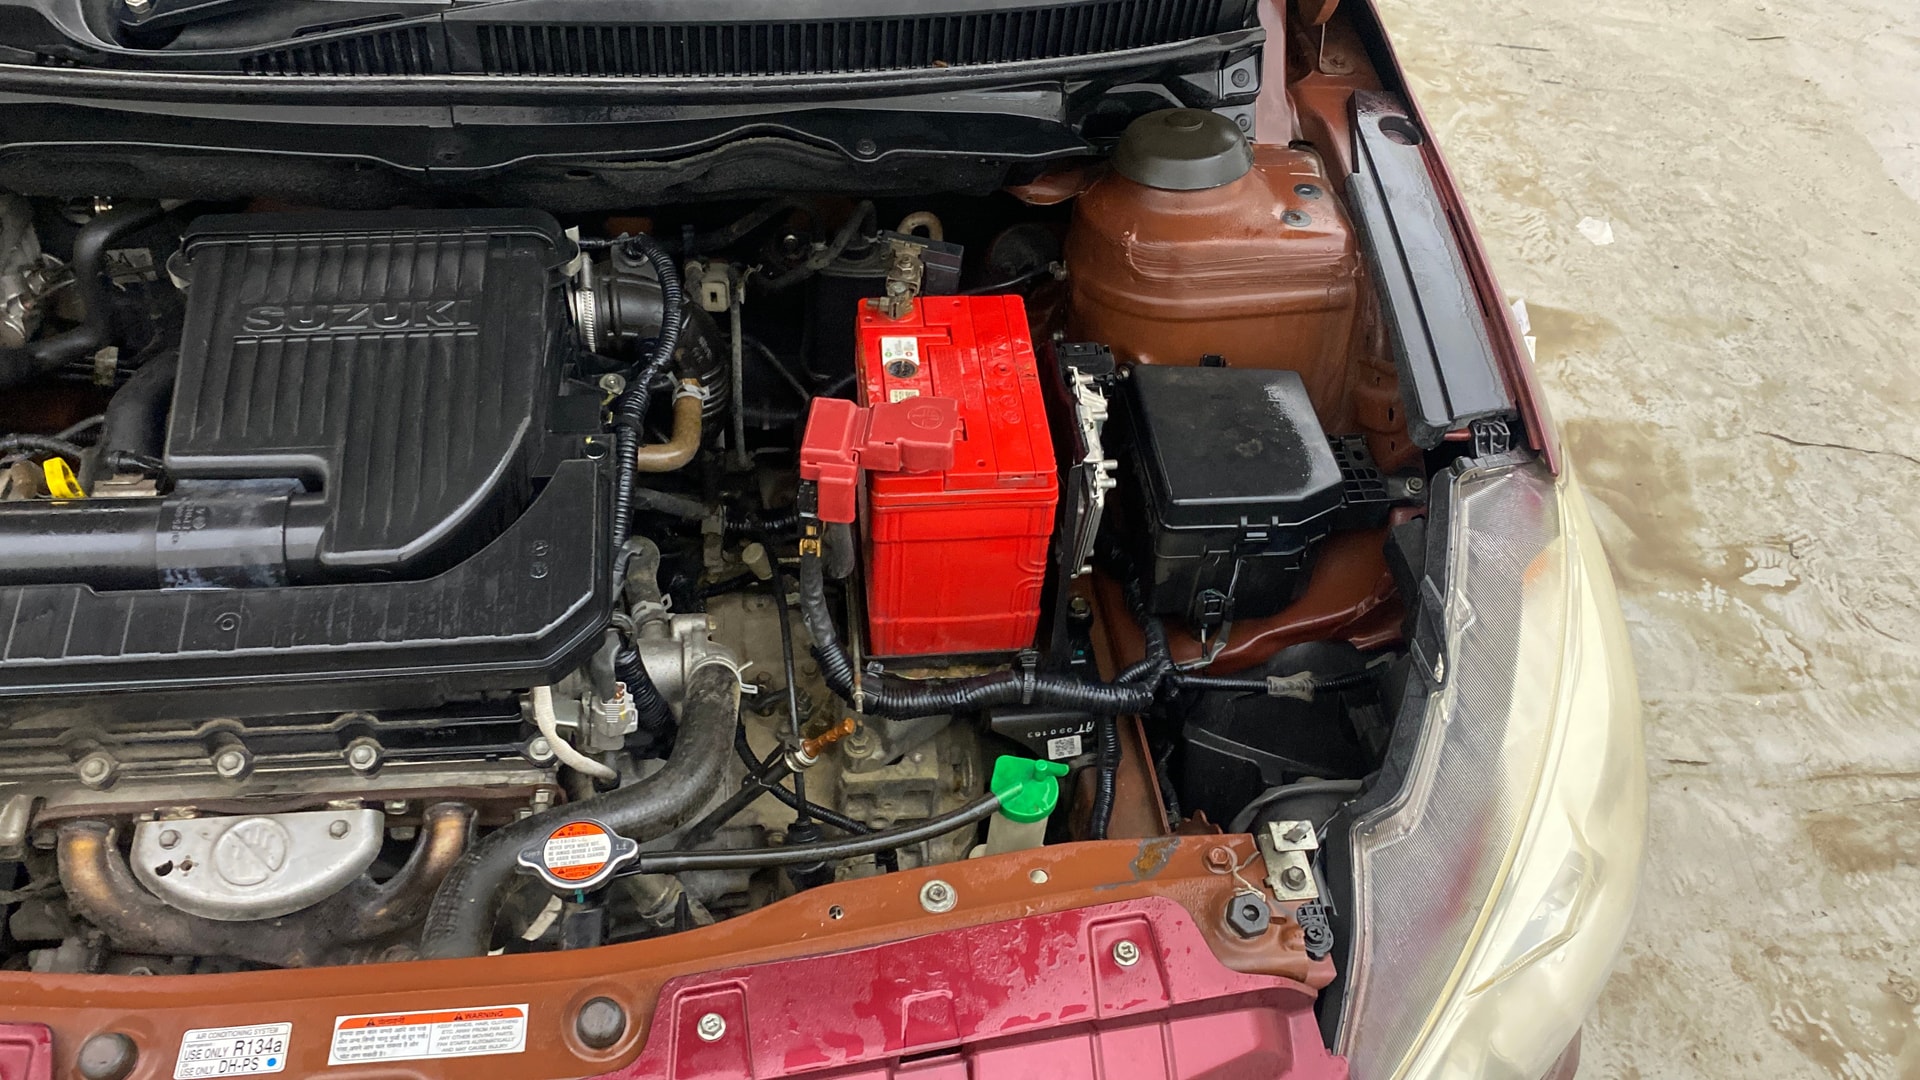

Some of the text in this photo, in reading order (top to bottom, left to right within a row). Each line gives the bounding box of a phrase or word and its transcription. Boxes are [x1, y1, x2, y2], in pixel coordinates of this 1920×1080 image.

[241, 299, 472, 333] SUZUKI
[464, 1010, 504, 1020] WARNING
[208, 1028, 253, 1038] CONDITIONING
[254, 1026, 279, 1035] SYSTEM
[184, 1037, 282, 1060] USE ONLY R134a
[180, 1057, 260, 1076] USE ONLY DH-PS
